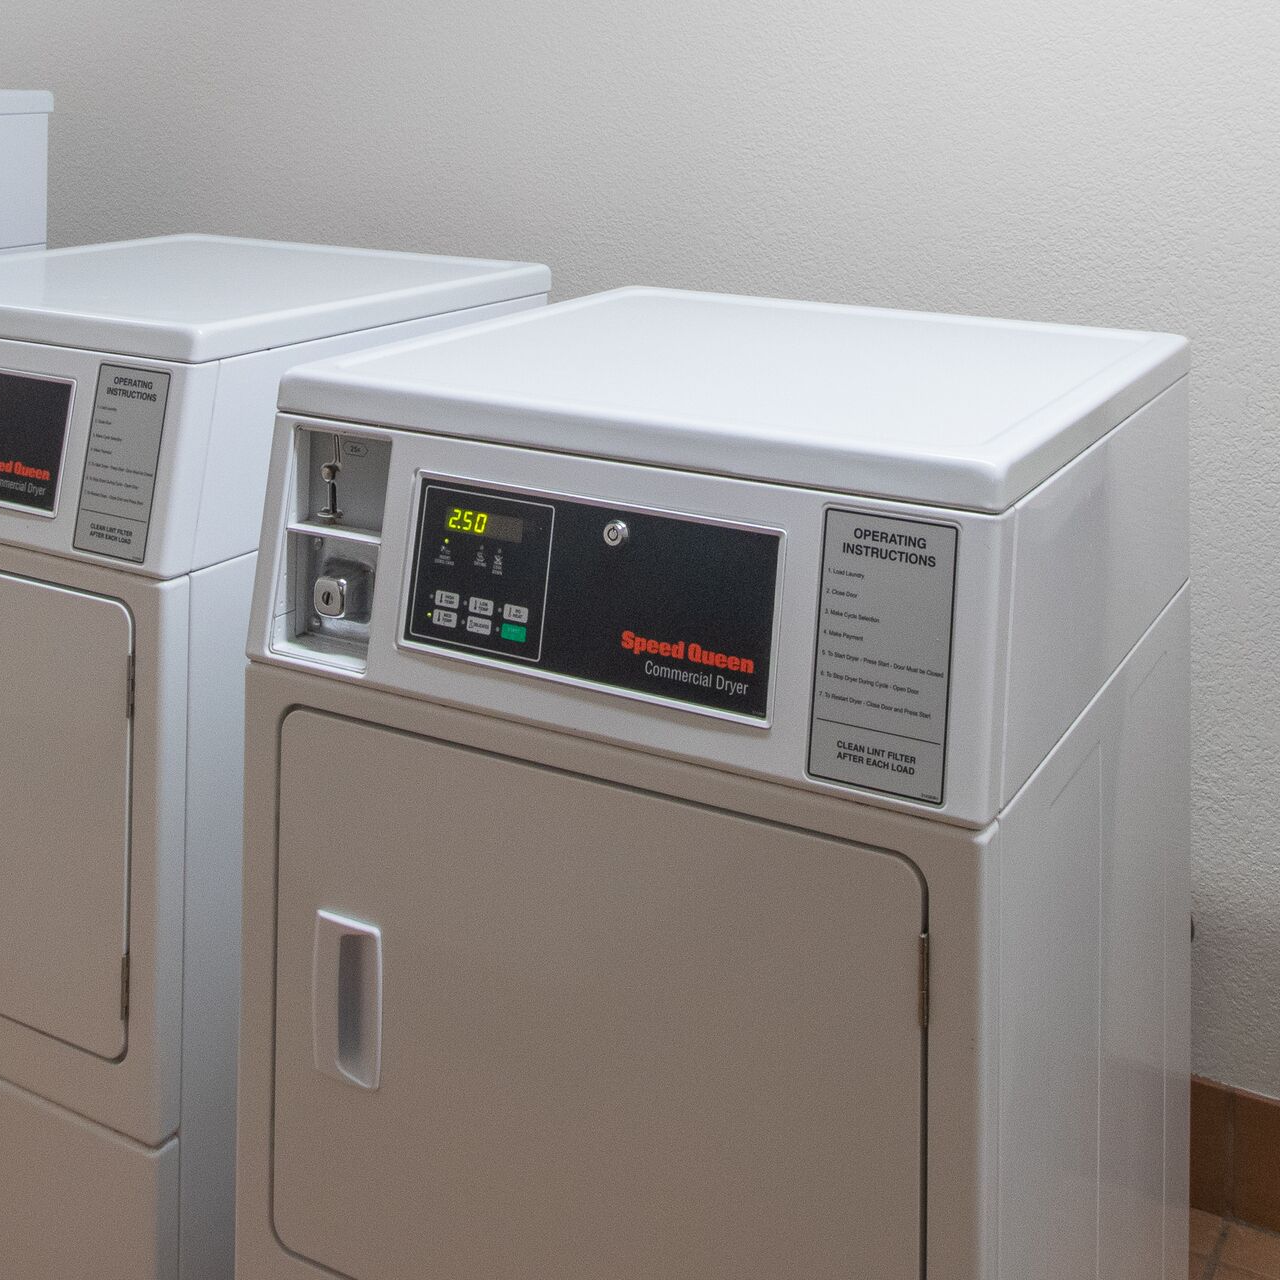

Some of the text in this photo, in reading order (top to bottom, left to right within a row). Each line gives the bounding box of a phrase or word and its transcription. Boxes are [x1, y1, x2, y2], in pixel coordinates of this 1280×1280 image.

[107, 387, 157, 401] INSTRUCTIONS
[114, 377, 153, 389] OPERATING
[14, 461, 50, 480] Queen
[28, 483, 46, 496] Dryer
[448, 509, 487, 533] 2.50
[854, 528, 926, 549] OPERATING
[843, 543, 936, 567] INSTRUCTIONS
[621, 630, 754, 673] Speed Queen
[645, 660, 749, 695] Commercial Dryer
[837, 740, 916, 764] CLEAN LINT FILTER
[837, 752, 914, 775] AFTER EACH LOAD
